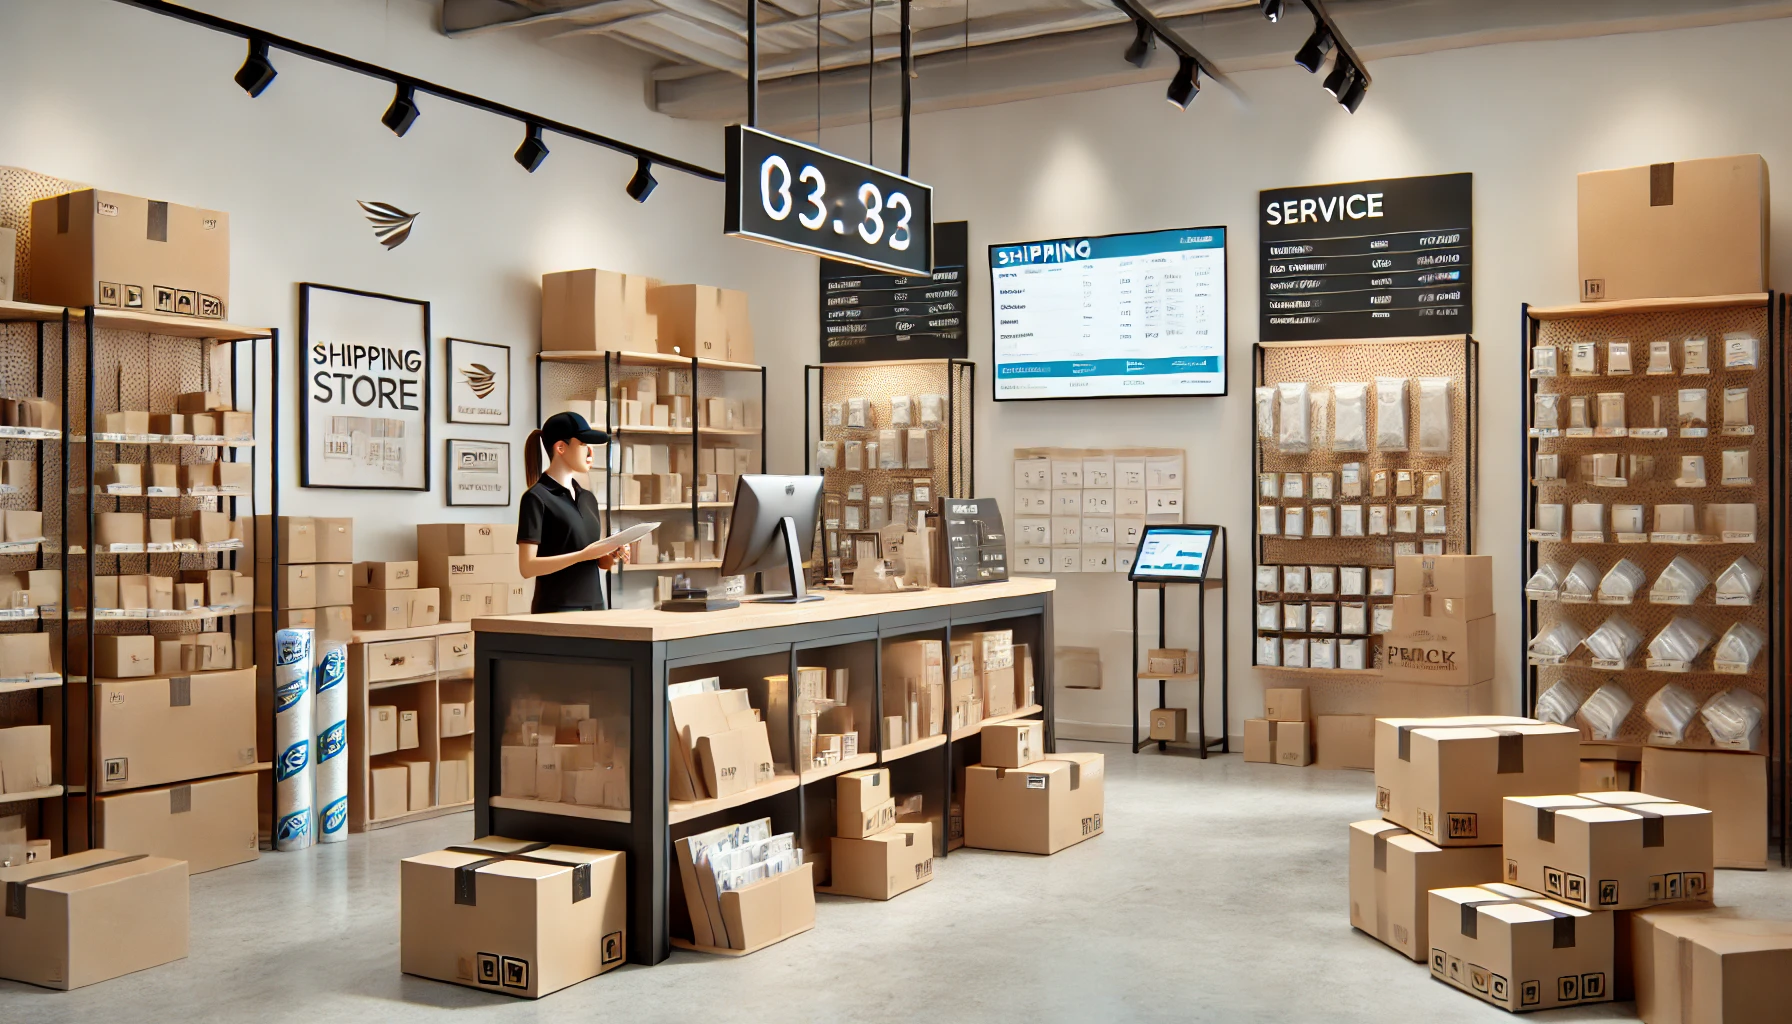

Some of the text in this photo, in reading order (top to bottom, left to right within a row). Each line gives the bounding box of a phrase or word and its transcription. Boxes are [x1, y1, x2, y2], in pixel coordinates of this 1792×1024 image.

[1266, 192, 1384, 226] SERVICE
[998, 239, 1091, 265] SHIPPING
[313, 341, 422, 372] SHIPPING
[313, 370, 419, 411] STORE
